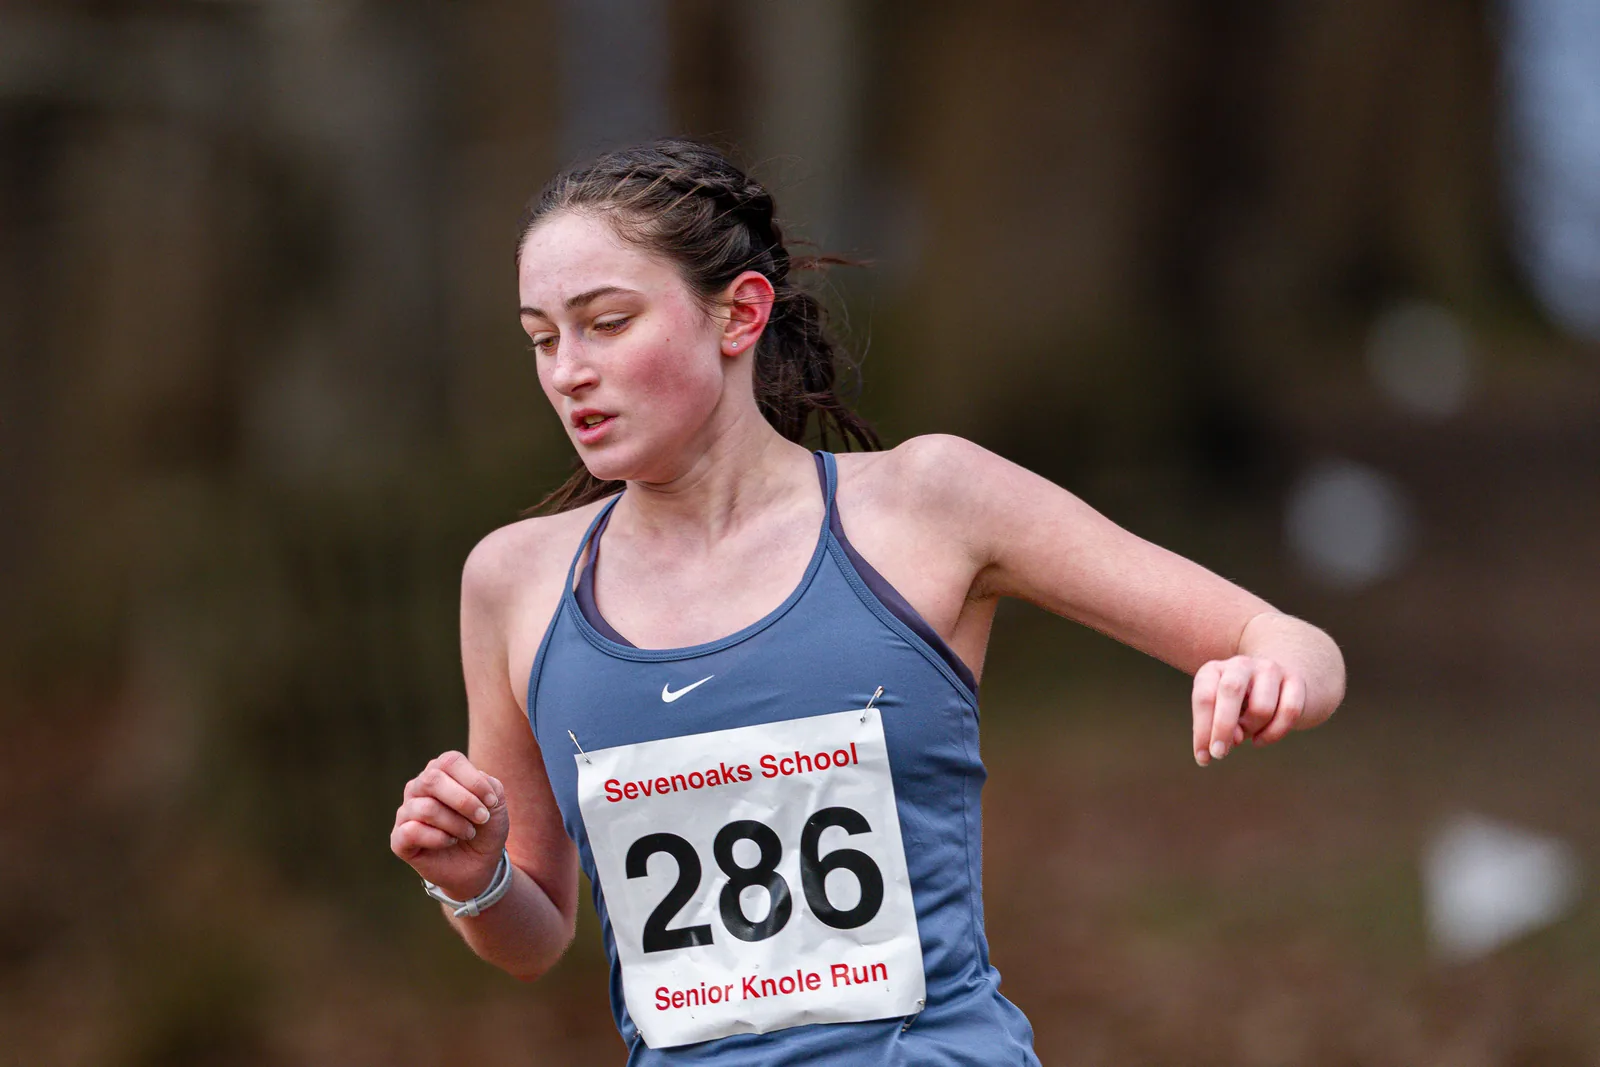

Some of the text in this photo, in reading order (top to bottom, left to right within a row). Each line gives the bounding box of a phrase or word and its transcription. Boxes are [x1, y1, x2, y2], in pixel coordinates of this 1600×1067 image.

[604, 742, 859, 803] Sevenoaks School
[625, 806, 885, 954] 286
[655, 962, 888, 1011] Senior Knole Run
